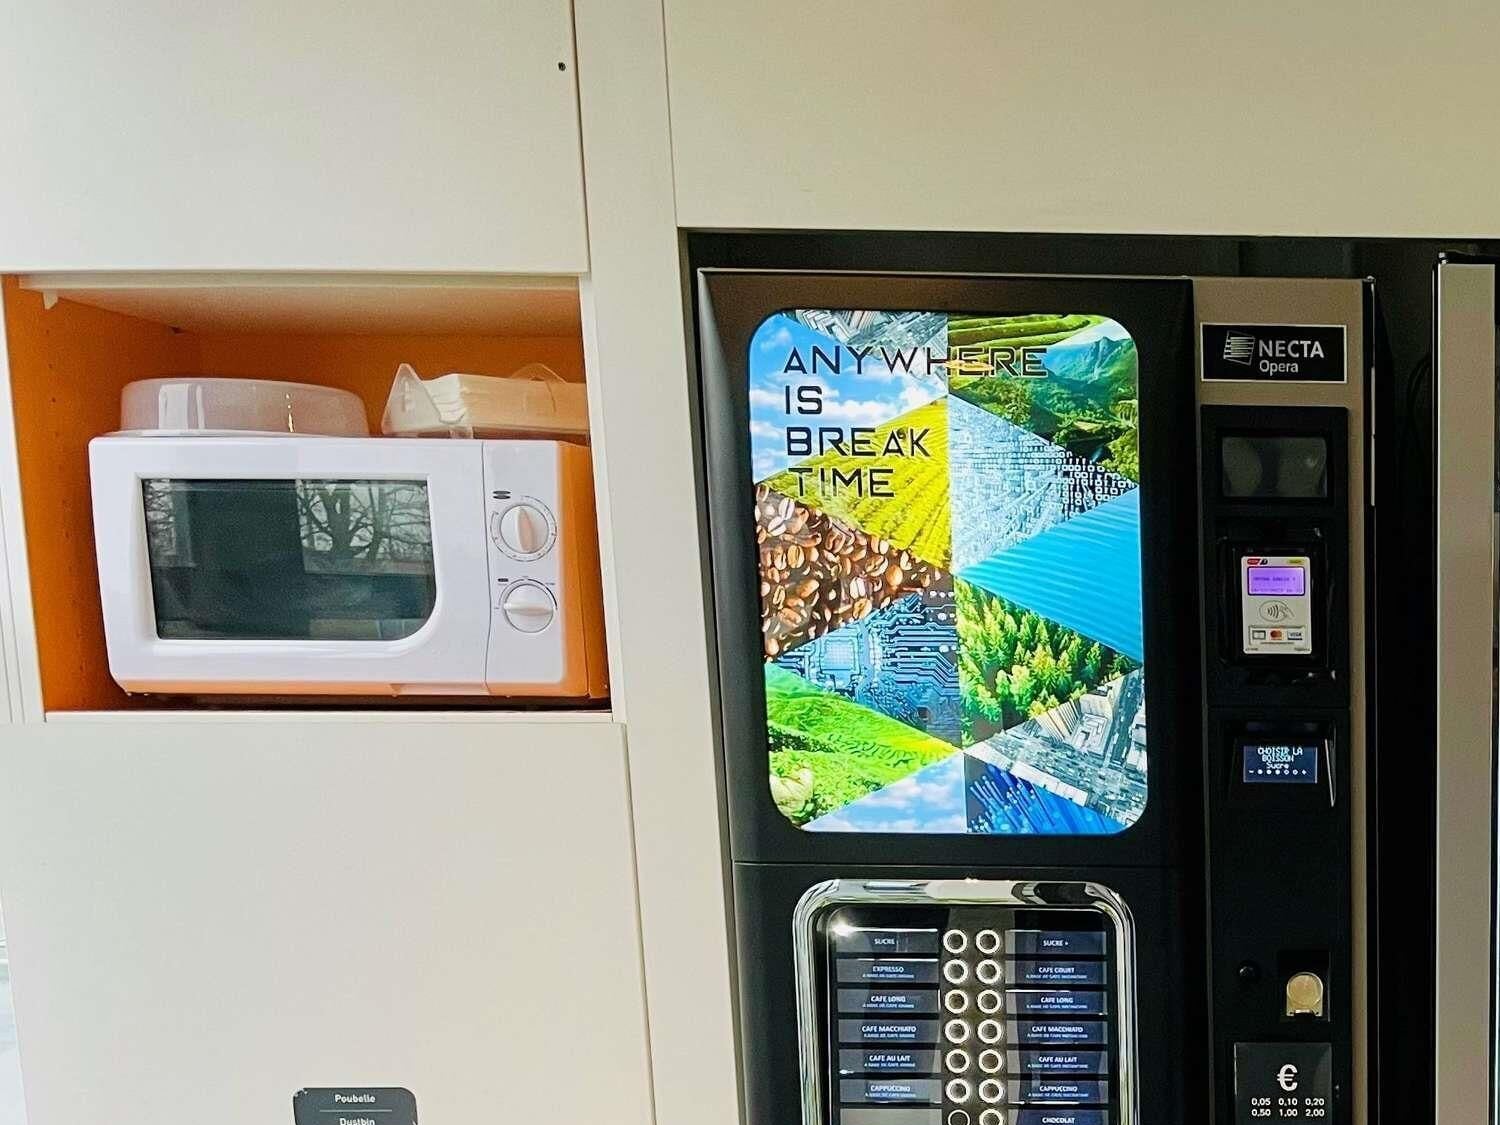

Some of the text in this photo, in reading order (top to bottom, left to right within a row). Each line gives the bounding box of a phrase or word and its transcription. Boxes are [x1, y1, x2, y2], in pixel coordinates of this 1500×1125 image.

[783, 345, 1048, 377] ANYWHERE
[1258, 340, 1325, 359] NECTA
[1259, 360, 1299, 376] Opera
[785, 385, 823, 415] IS
[787, 426, 931, 457] BREAK
[789, 467, 895, 498] TIME
[1257, 747, 1303, 755] CHOISIR LA
[1266, 762, 1290, 770] Sucre
[1277, 1064, 1298, 1091] €
[334, 1094, 376, 1103] Poubelle
